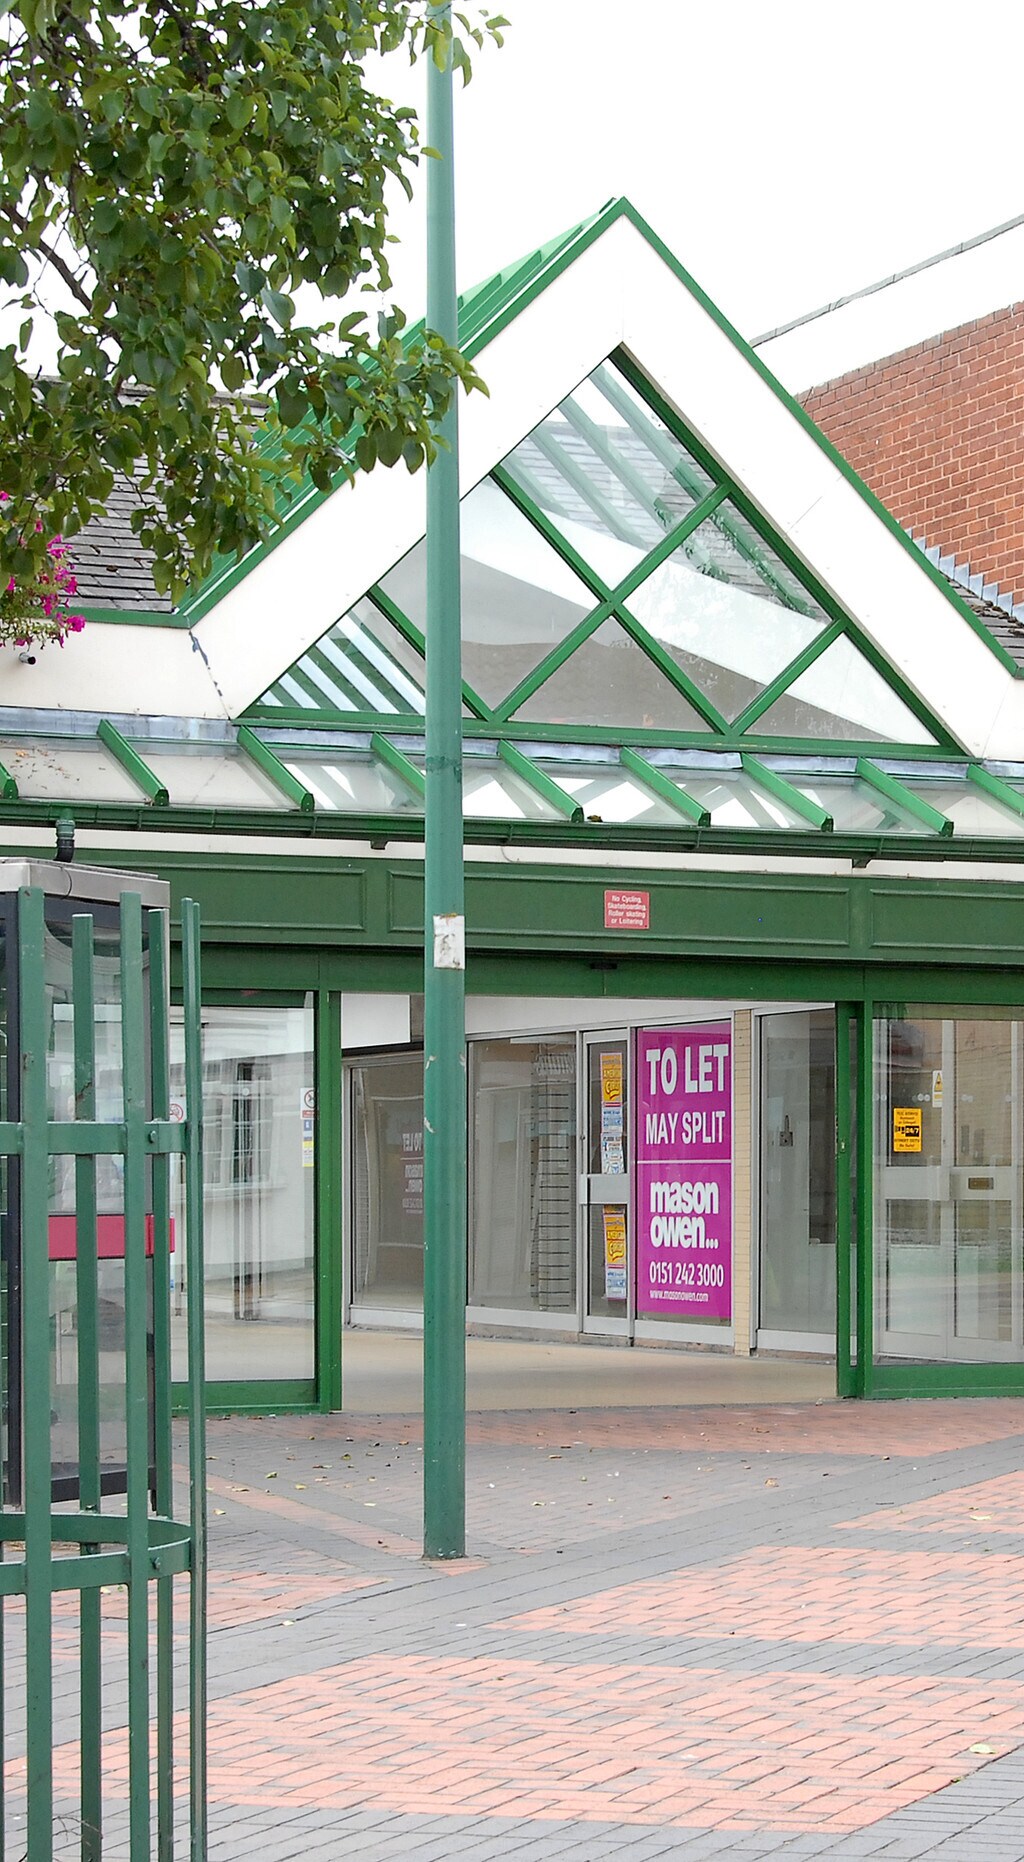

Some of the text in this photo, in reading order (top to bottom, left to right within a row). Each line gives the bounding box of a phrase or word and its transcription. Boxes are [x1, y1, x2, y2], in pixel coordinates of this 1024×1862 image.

[646, 1043, 729, 1095] TO LET
[645, 1112, 679, 1145] MAY
[681, 1110, 726, 1145] SPLIT
[650, 1181, 719, 1214] mason
[650, 1215, 719, 1249] owen...
[649, 1261, 673, 1284] 0151
[675, 1262, 695, 1286] 242
[696, 1263, 724, 1287] 3000
[649, 1289, 709, 1302] www.masonowen.com
